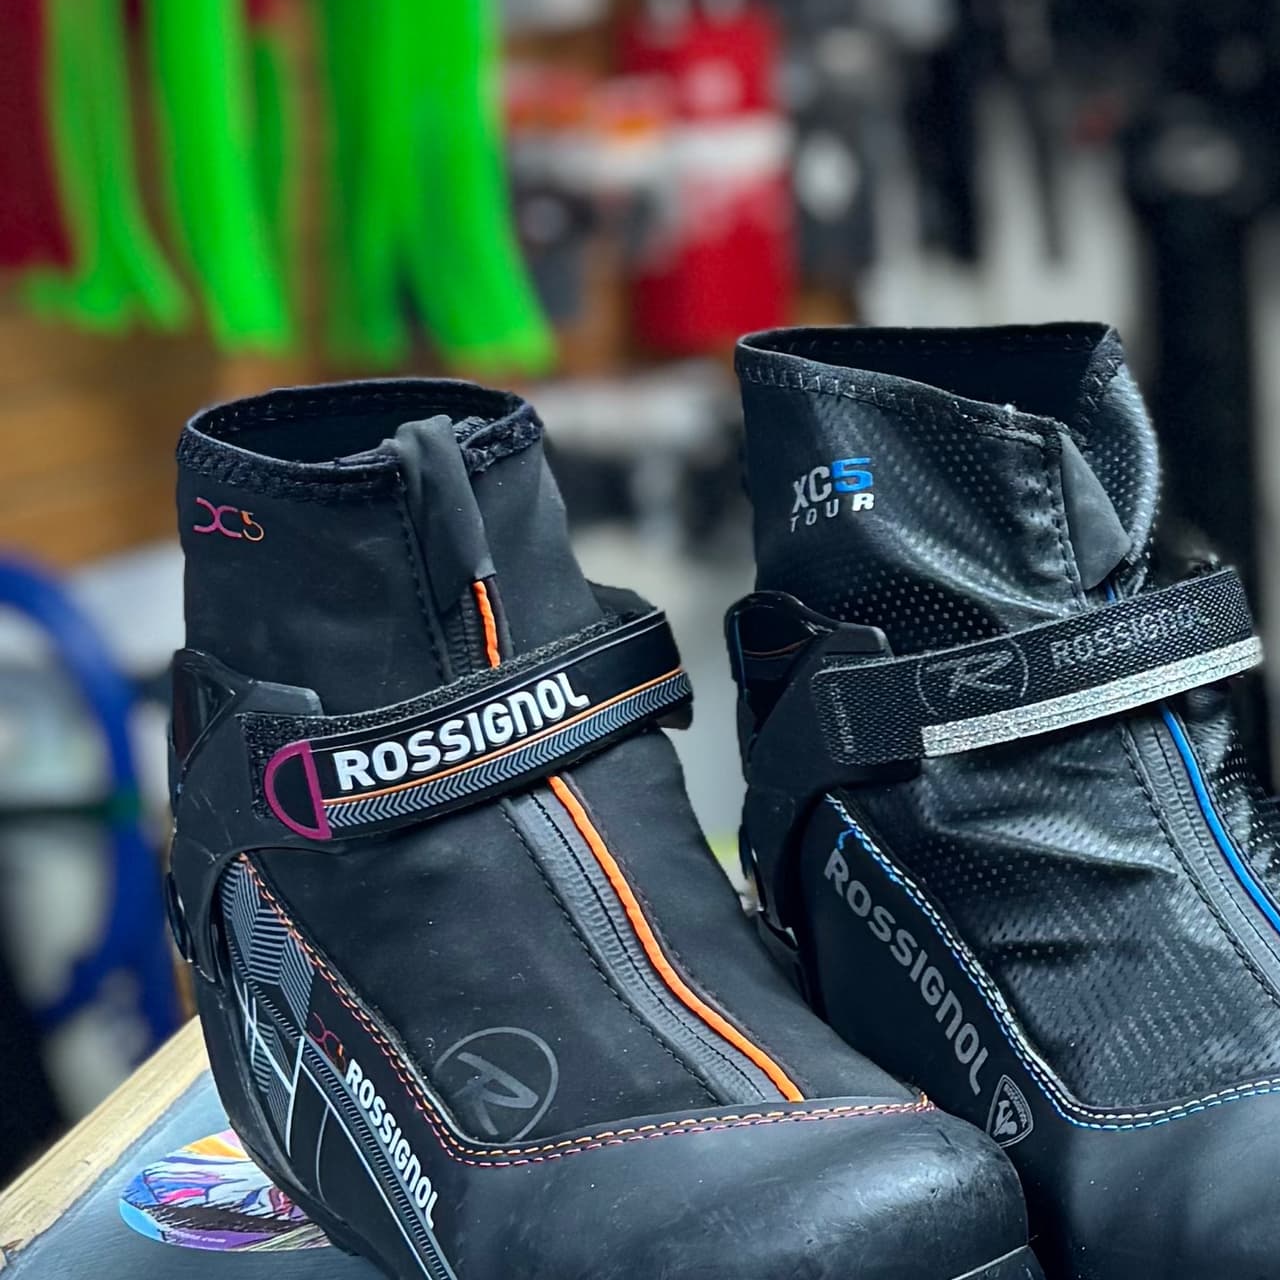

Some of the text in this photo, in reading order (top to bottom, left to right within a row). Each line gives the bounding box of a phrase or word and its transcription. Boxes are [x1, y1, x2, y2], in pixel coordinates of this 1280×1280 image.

[790, 492, 875, 533] TOUR
[791, 457, 874, 514] XC5
[333, 672, 590, 790] ROSSIGNOL
[824, 848, 988, 1096] ROSSIGNOL
[345, 1058, 438, 1230] ROSSIGNOL
